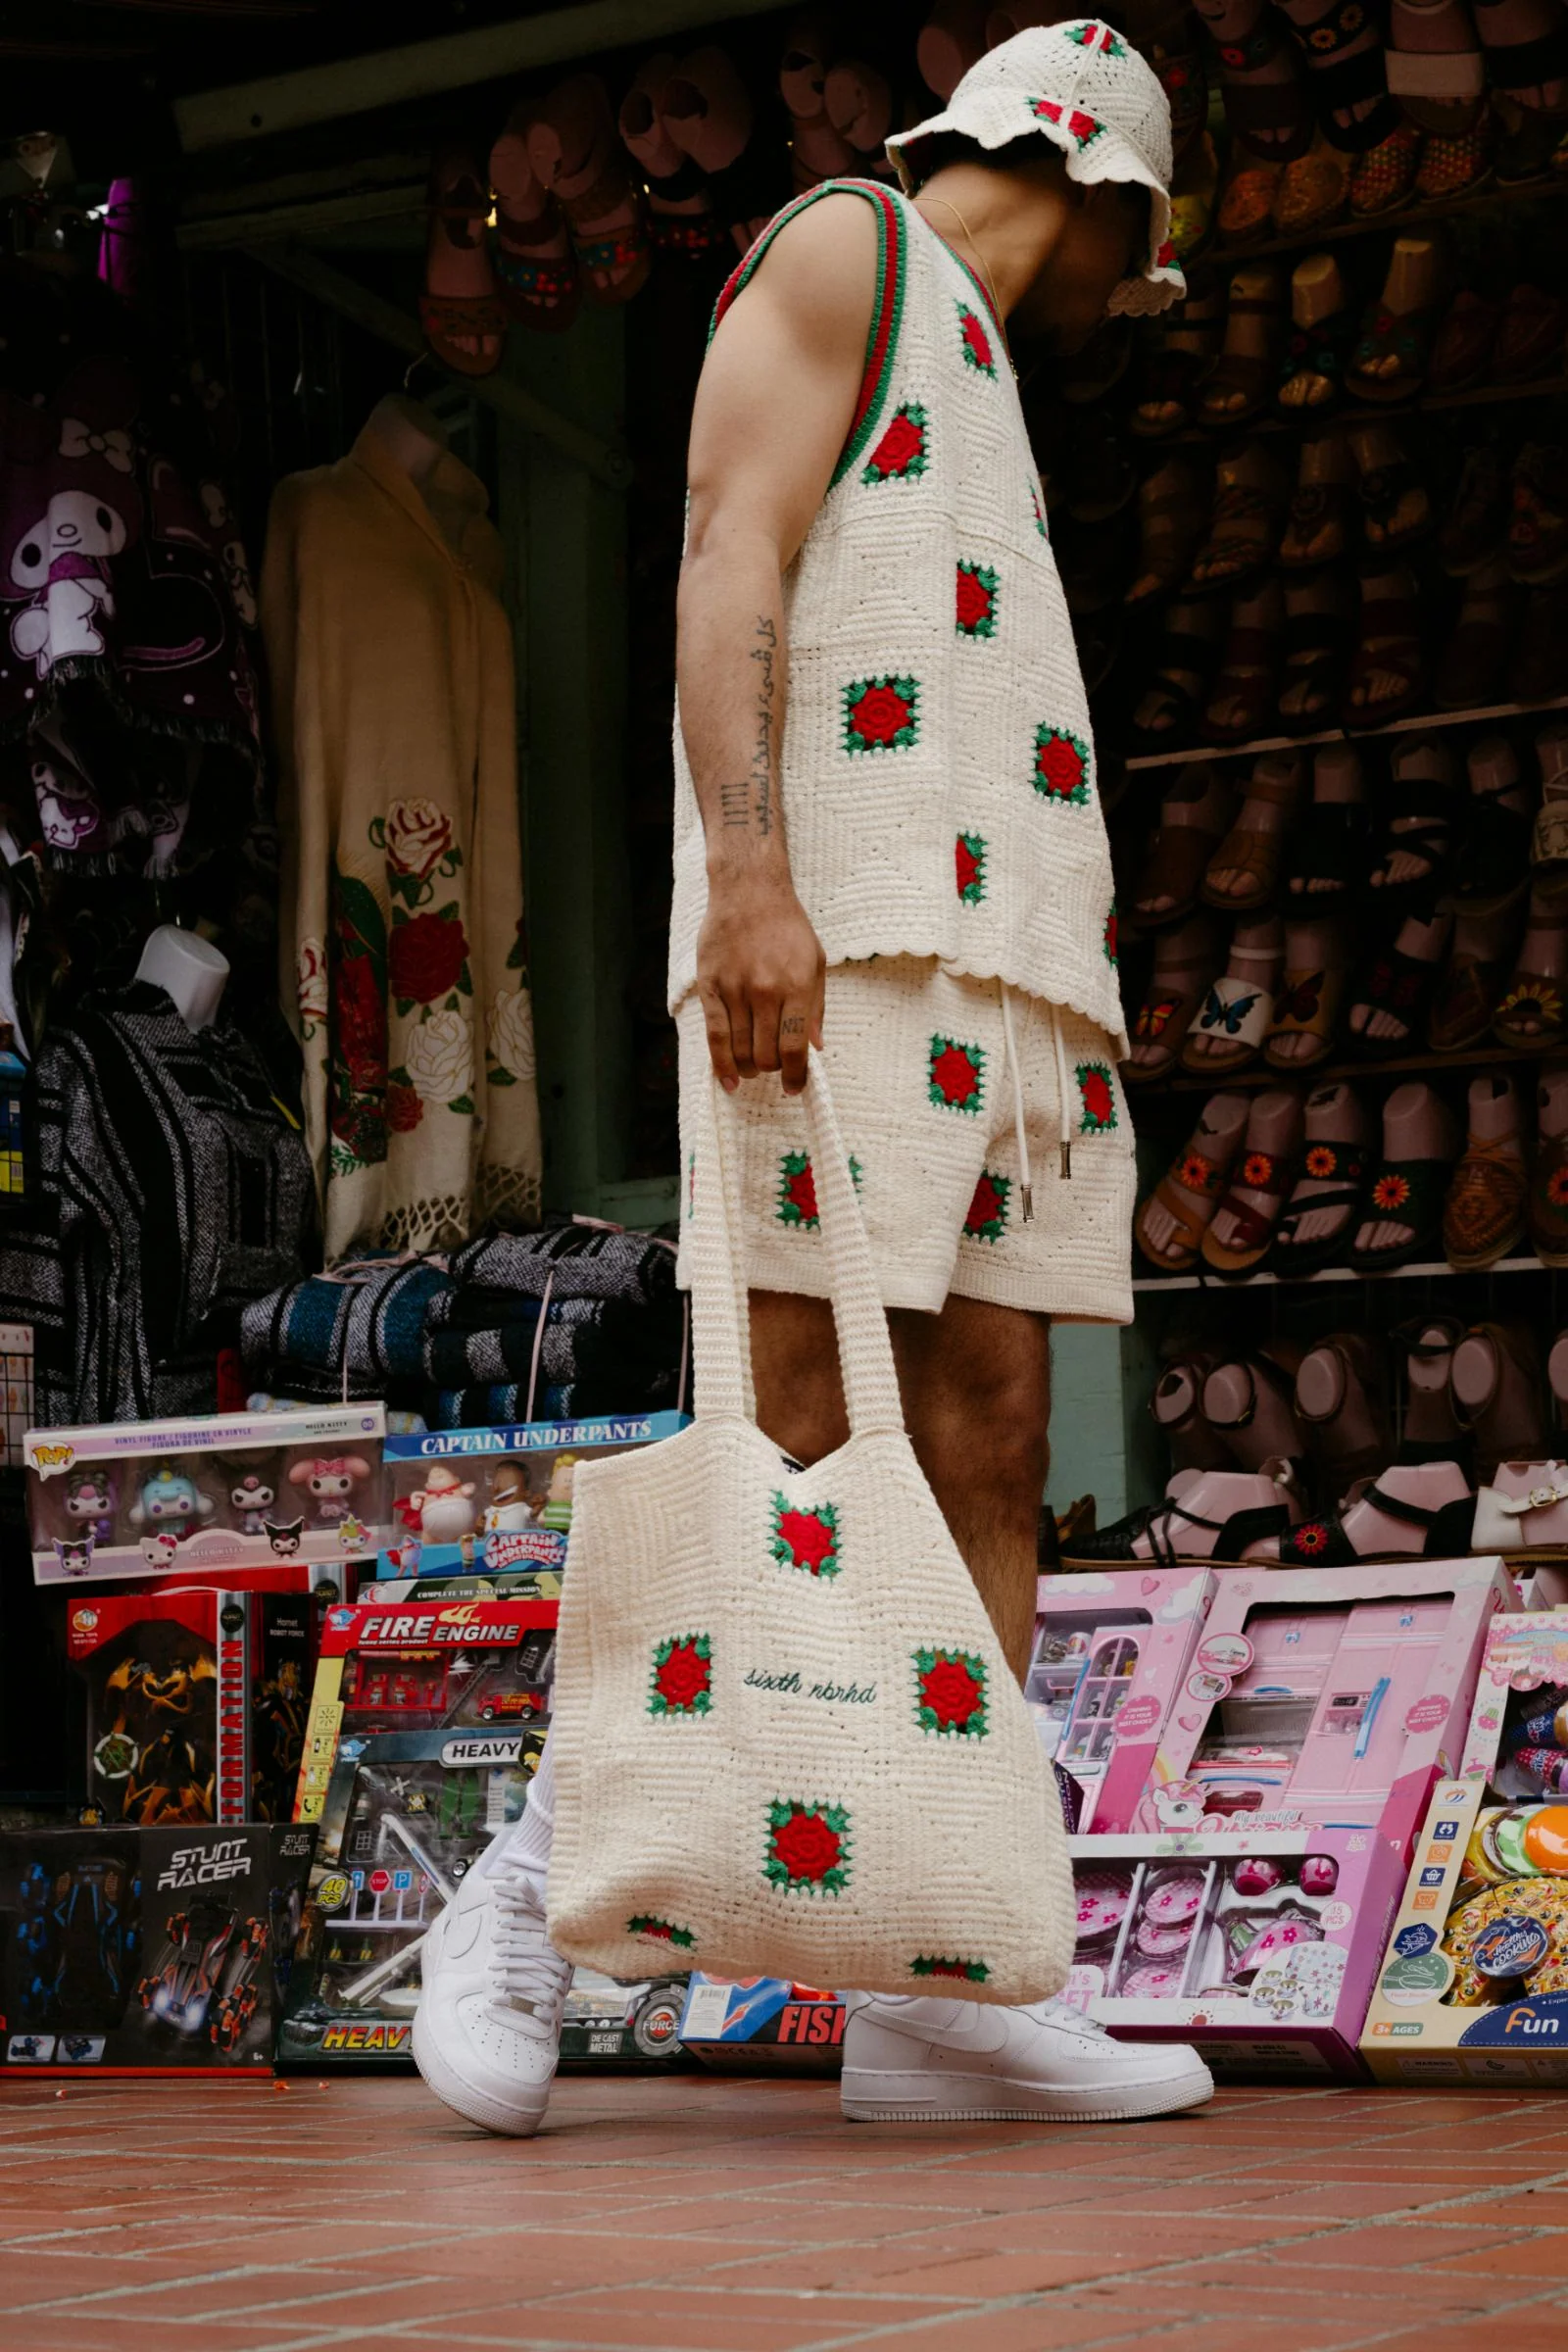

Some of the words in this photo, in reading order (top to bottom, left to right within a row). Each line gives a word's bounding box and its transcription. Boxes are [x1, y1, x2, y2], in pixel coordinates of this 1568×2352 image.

[421, 1432, 507, 1455] CAPTAIN
[514, 1420, 652, 1448] UNDERPANTS
[31, 1446, 74, 1467] POP!
[416, 1591, 457, 1599] COMPLETE
[459, 1589, 474, 1597] THE
[475, 1587, 508, 1596] SPECIAL
[509, 1585, 542, 1594] MISSION
[360, 1615, 436, 1640] FIRE
[432, 1625, 520, 1642] ENGINE
[743, 1668, 803, 1694] sixth
[220, 1640, 244, 1827] FORMATION
[452, 1741, 519, 1758] HEAVY
[284, 1834, 311, 1845] STUNT
[170, 1838, 248, 1870] STUNT
[278, 1844, 311, 1857] RACER
[157, 1856, 252, 1892] RACER
[321, 1878, 347, 1894] 40
[315, 1892, 342, 1905] PCS
[642, 2019, 681, 2032] FORCE
[1504, 2007, 1559, 2034] Fun
[321, 2026, 413, 2050] HEAV
[602, 2033, 620, 2042] CAST
[1392, 2025, 1420, 2034] AGES
[588, 2042, 617, 2053] METAL
